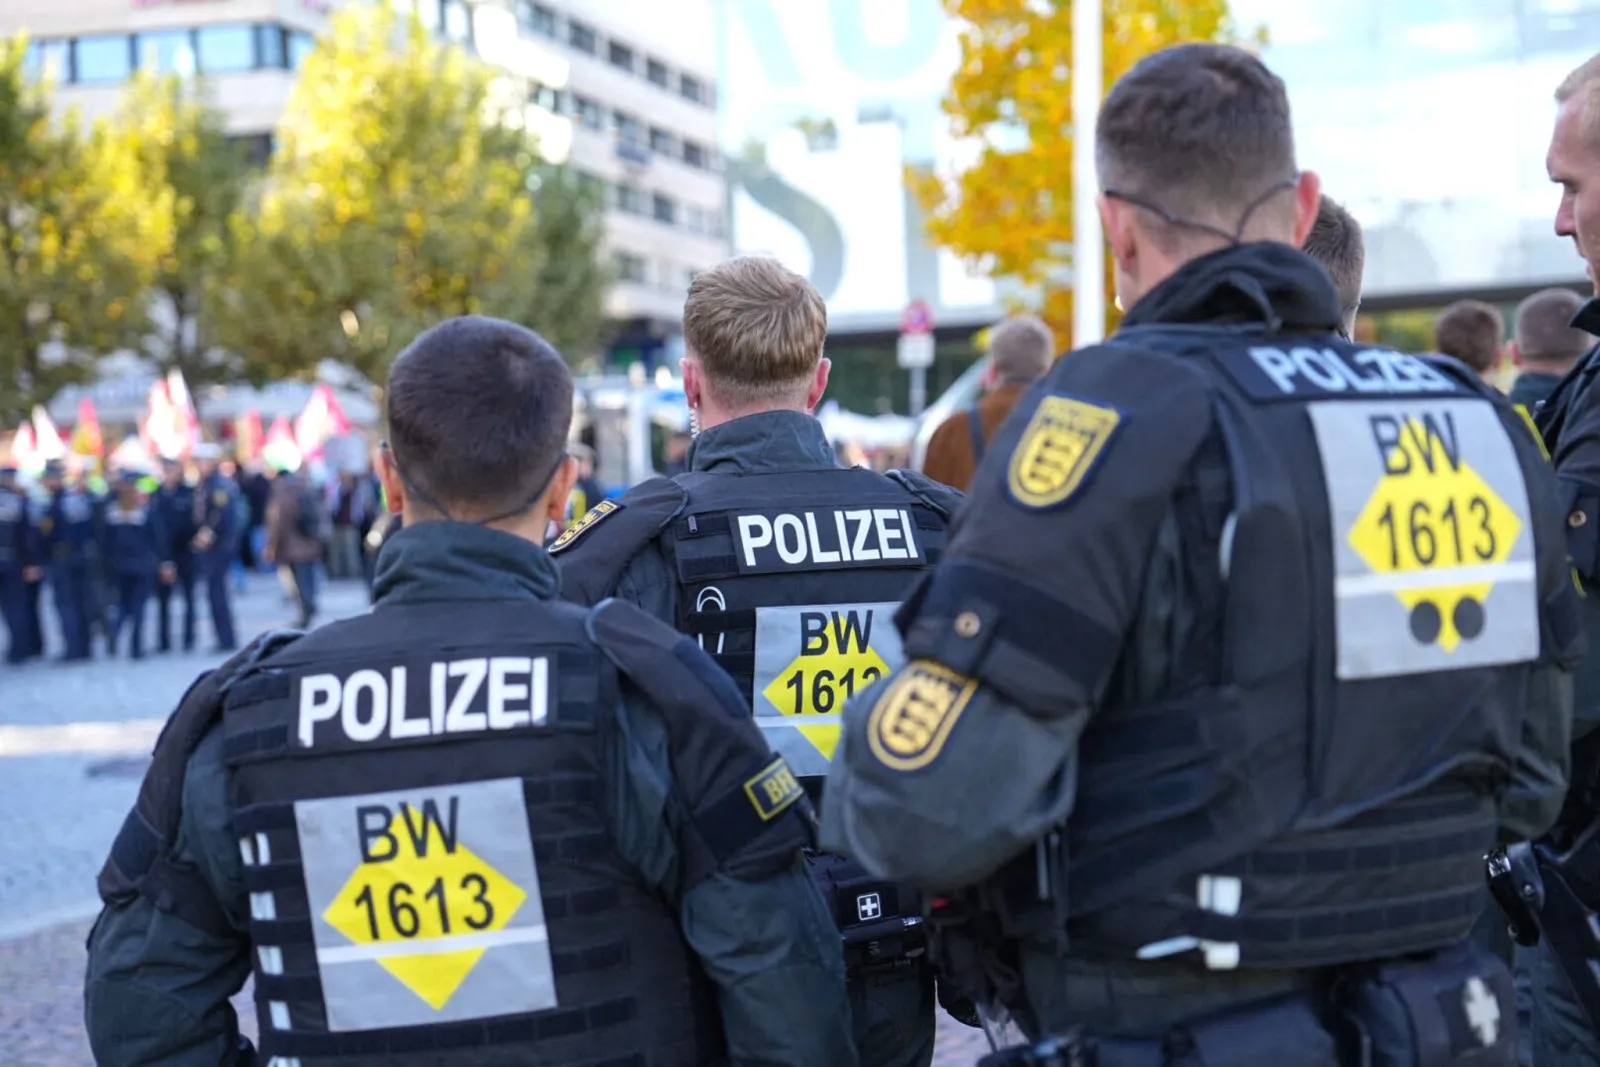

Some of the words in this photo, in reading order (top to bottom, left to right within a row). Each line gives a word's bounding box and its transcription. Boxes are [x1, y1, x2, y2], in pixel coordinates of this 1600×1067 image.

[1368, 411, 1462, 476] BW
[737, 508, 919, 567] POLIZEI
[1378, 496, 1497, 569] 1613
[800, 609, 873, 657] BW
[298, 656, 549, 748] POLIZEI
[356, 796, 459, 865] BW
[354, 873, 496, 941] 1613
